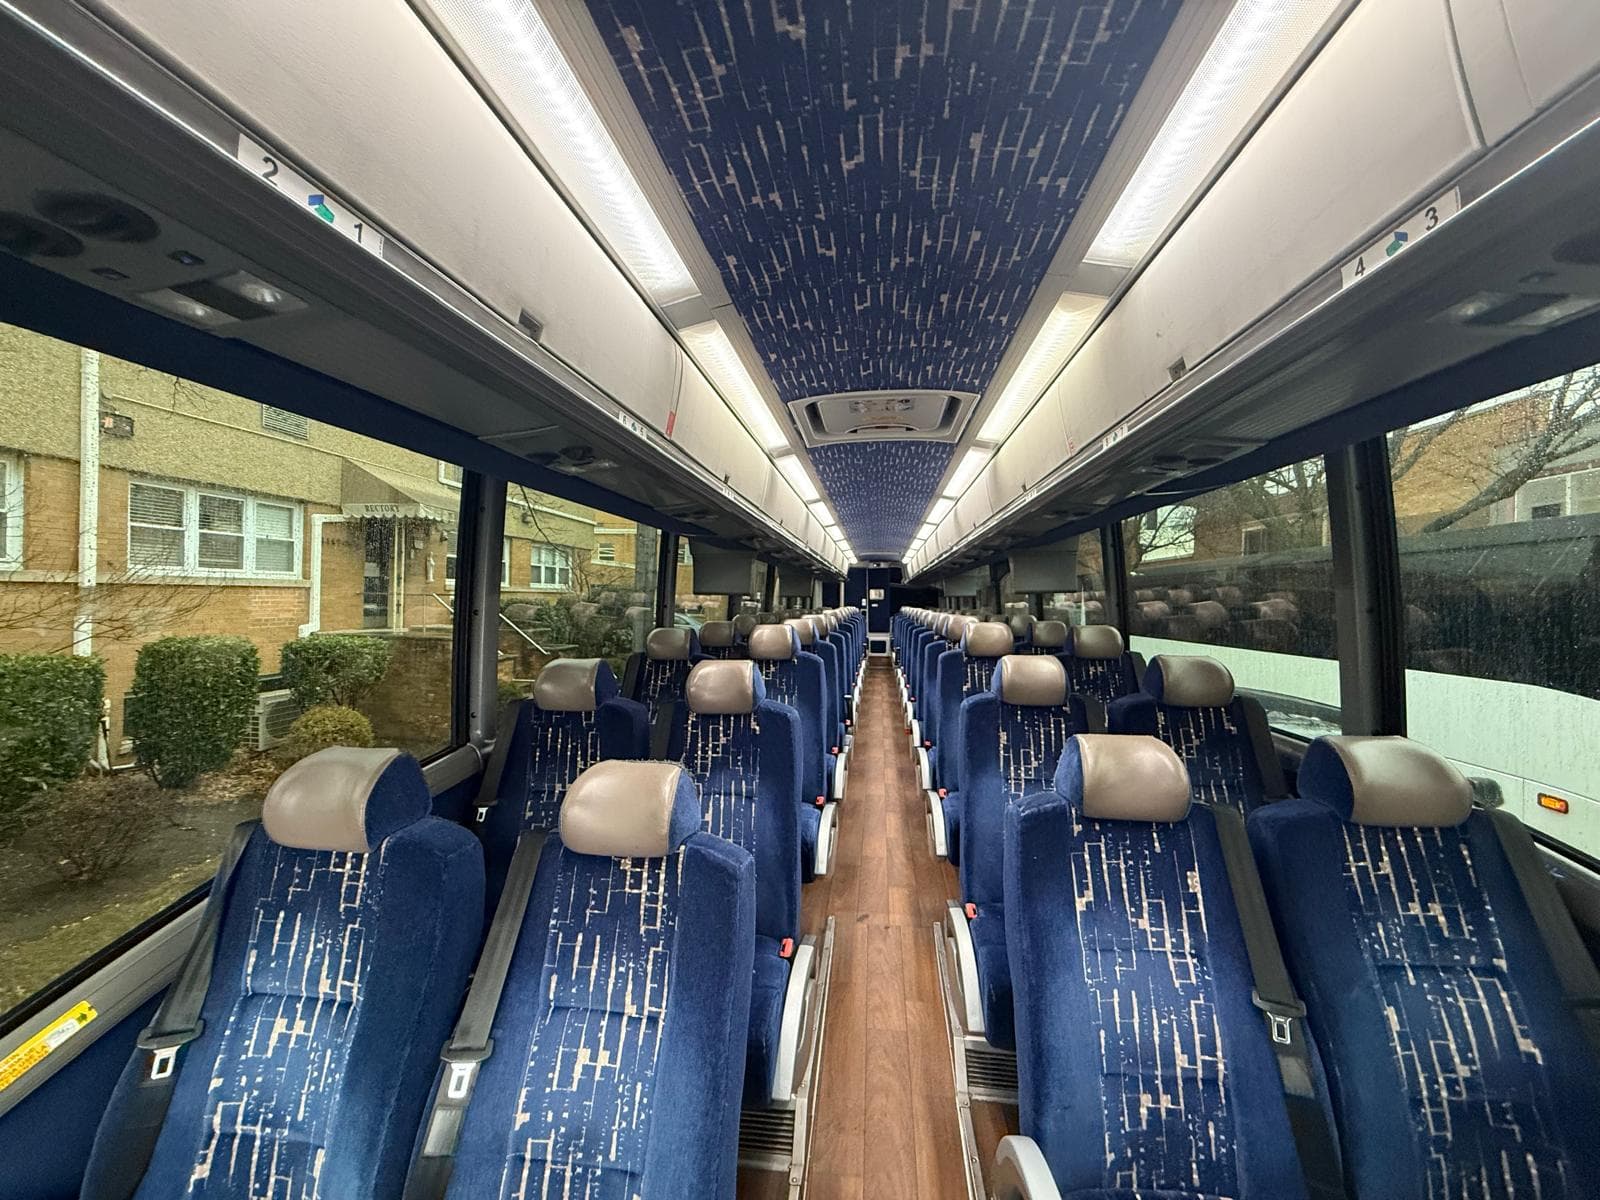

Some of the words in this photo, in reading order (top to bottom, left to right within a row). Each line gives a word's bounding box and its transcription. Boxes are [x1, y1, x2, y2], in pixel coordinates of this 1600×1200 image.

[262, 156, 278, 186] 2
[354, 222, 363, 243] 1
[1354, 256, 1366, 276] 4
[1425, 206, 1438, 231] 3
[364, 504, 400, 513] RECTORY
